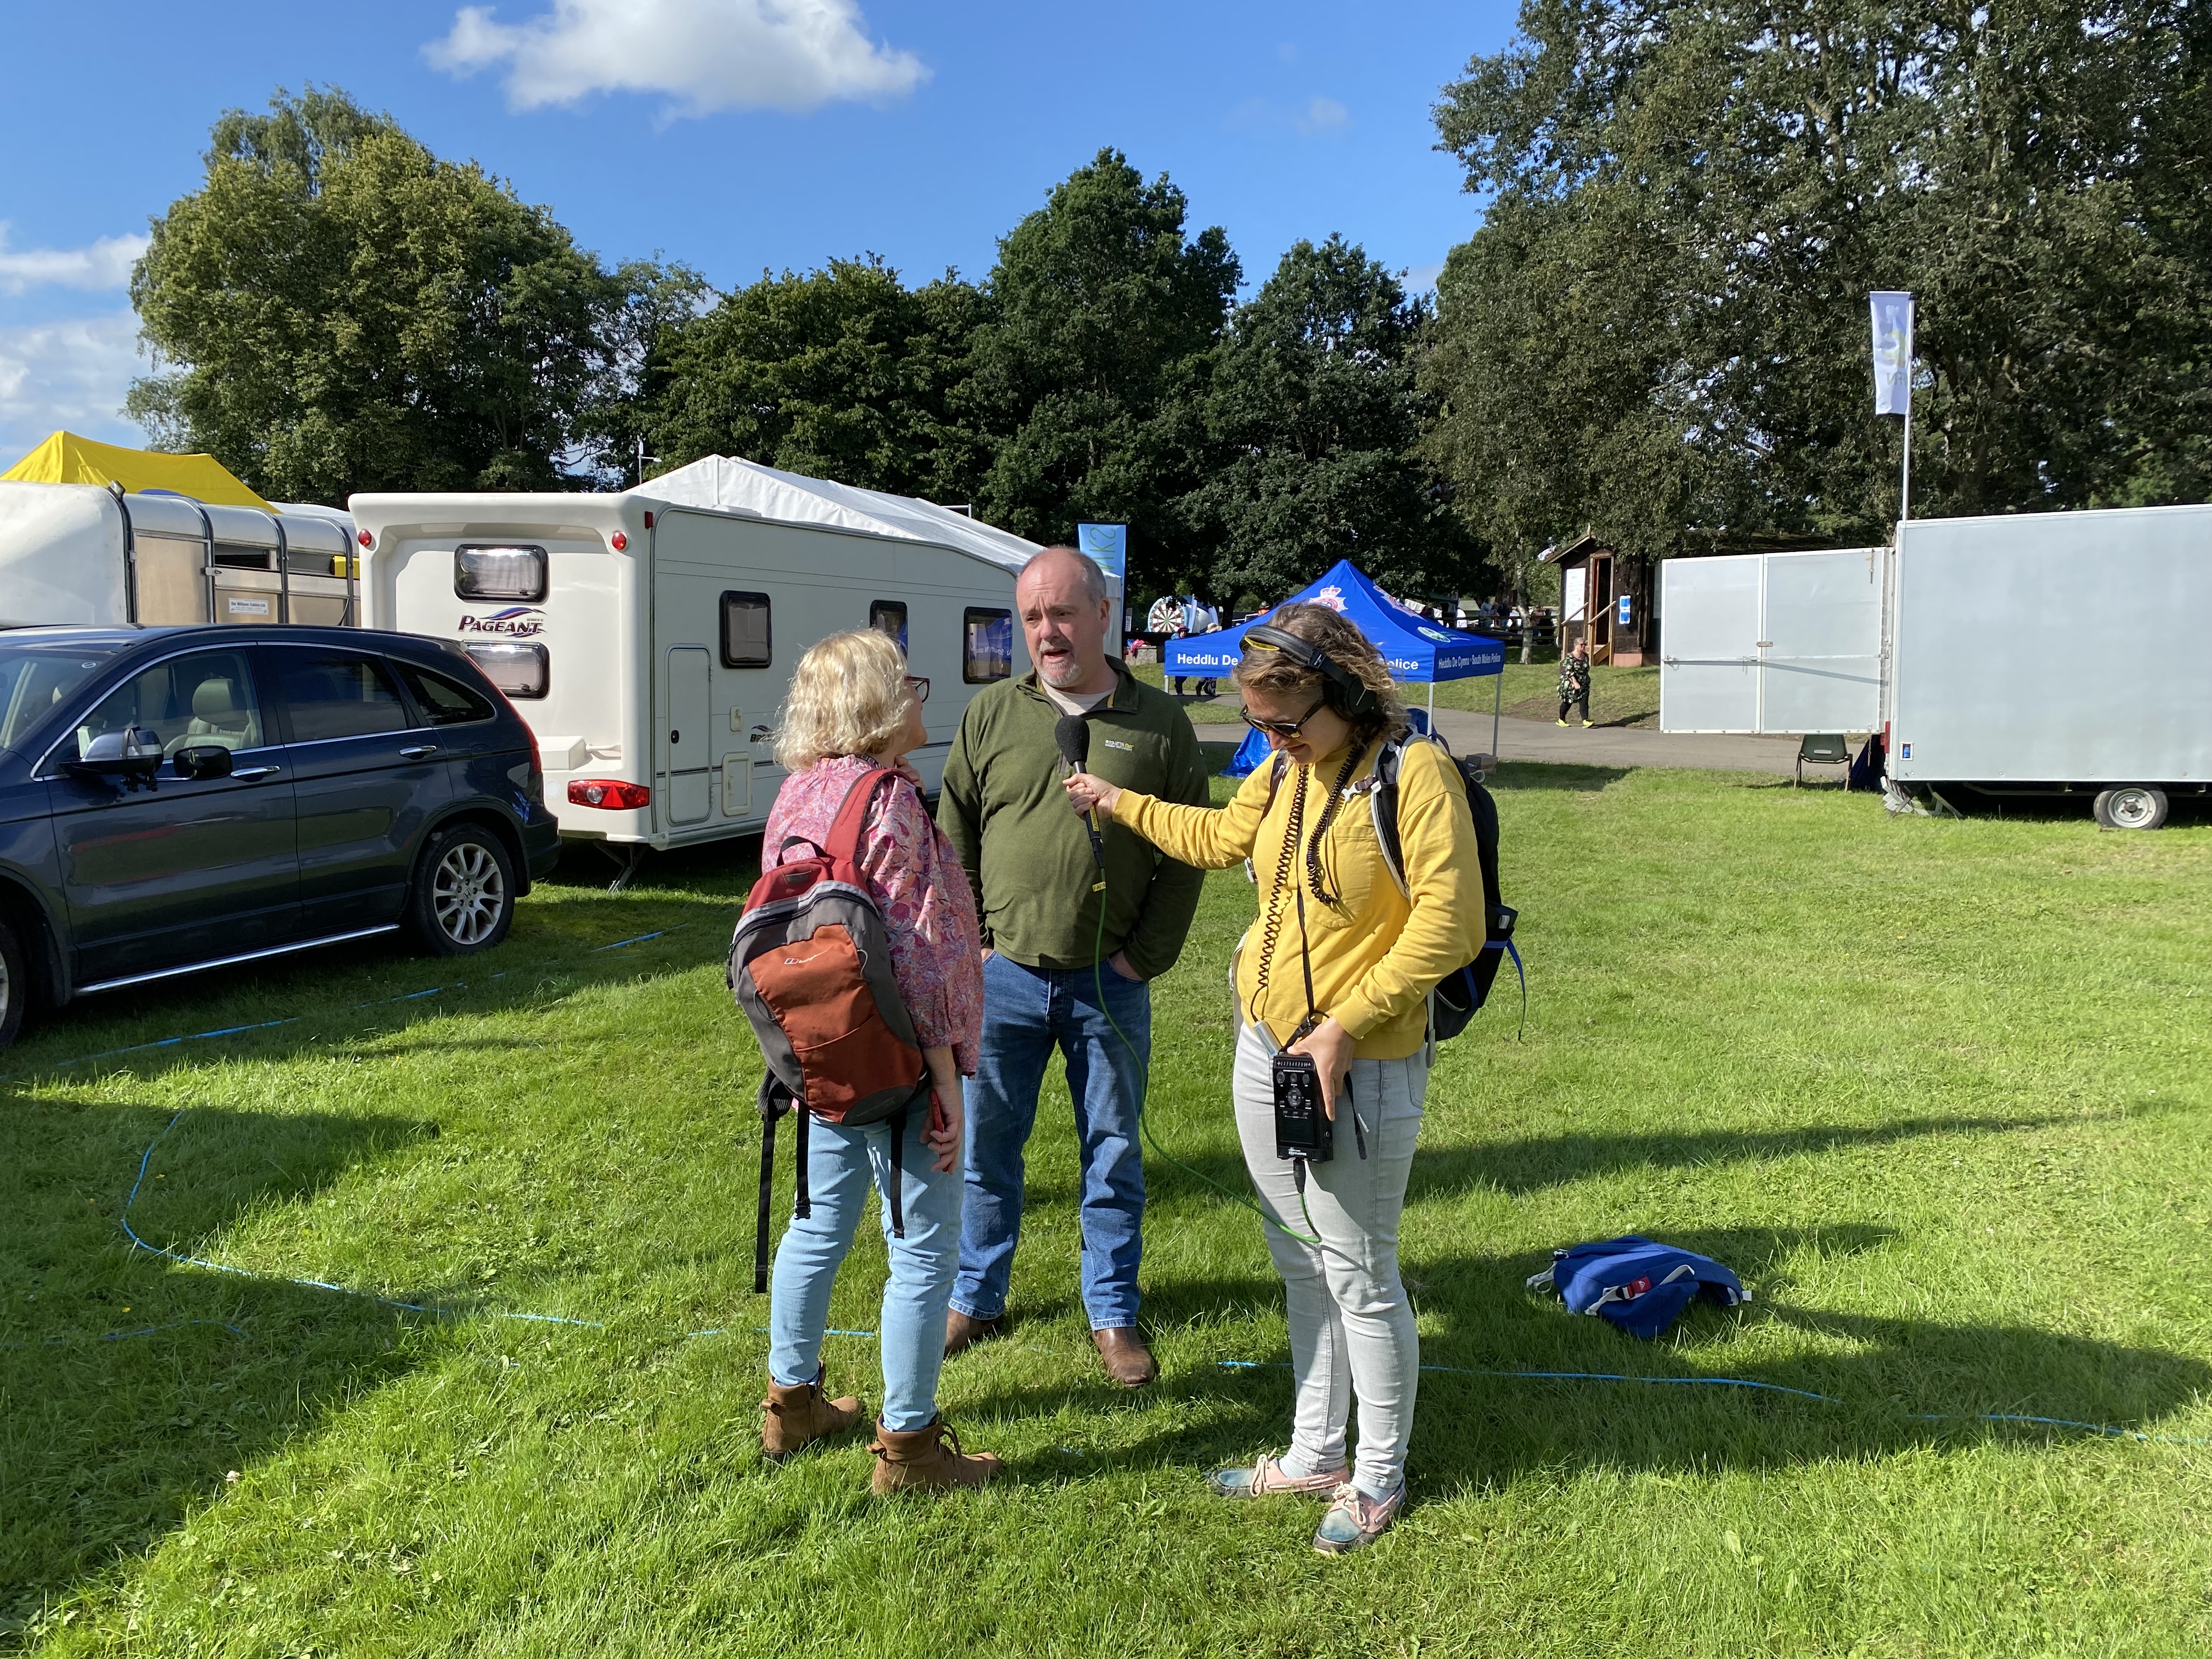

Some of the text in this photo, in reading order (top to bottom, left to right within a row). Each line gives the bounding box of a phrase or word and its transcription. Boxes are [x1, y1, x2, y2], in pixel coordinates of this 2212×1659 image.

[458, 615, 543, 634] PAGEANT
[1177, 653, 1218, 665] Heddlu
[1222, 654, 1238, 665] De
[1438, 653, 1501, 669] Heddlu De Cymru South Wales Police
